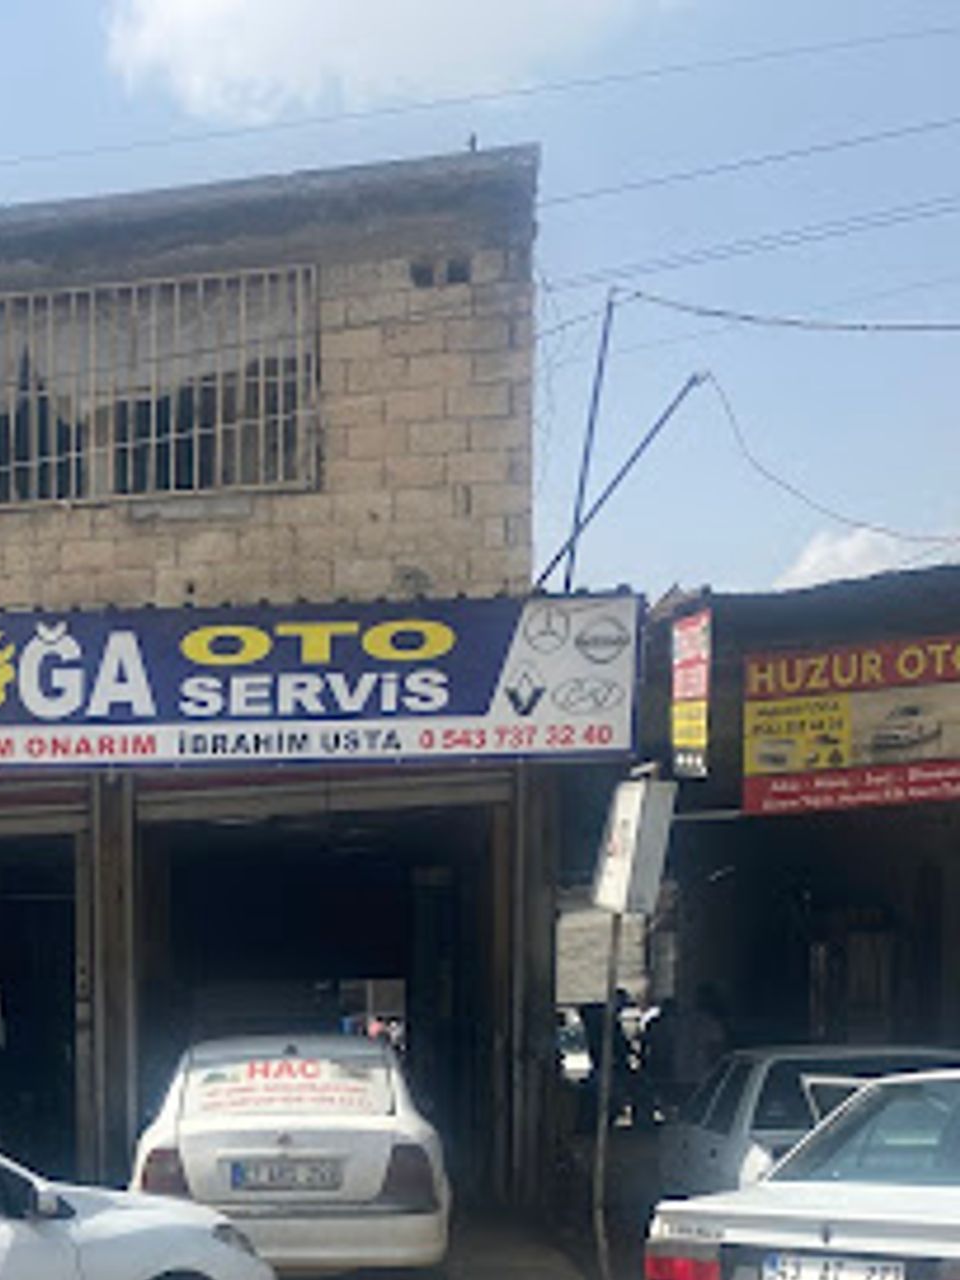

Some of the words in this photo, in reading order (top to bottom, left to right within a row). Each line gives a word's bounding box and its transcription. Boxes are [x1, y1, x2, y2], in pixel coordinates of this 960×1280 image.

[179, 618, 457, 666] OTO
[178, 669, 449, 717] SERVİS
[748, 651, 883, 693] HUZUR
[26, 734, 158, 757] ONARIM
[177, 731, 309, 756] İBRAHİM
[321, 729, 402, 752] USTA
[418, 729, 435, 751] 0
[442, 728, 487, 749] 543
[545, 725, 575, 746] 32
[583, 724, 613, 745] 40
